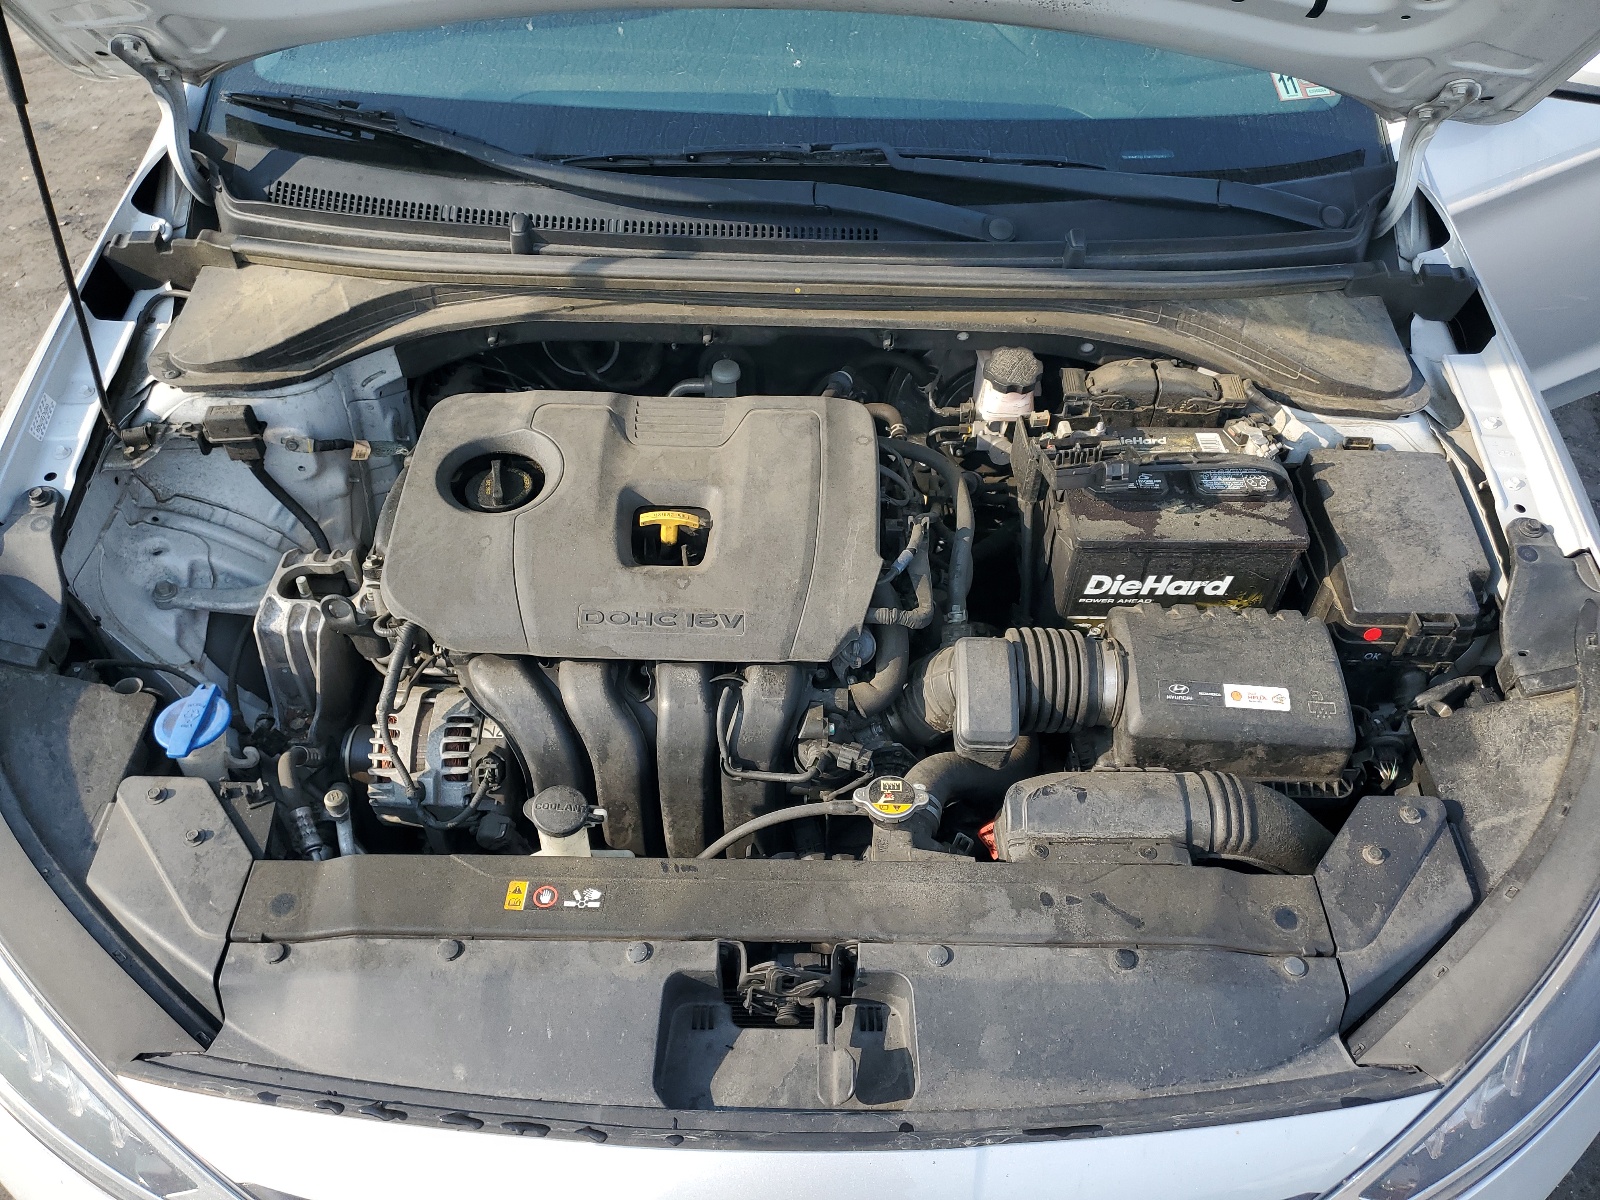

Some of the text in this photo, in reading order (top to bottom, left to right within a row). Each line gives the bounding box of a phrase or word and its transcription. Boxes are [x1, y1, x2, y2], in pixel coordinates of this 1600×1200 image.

[1278, 74, 1299, 95] 11
[1118, 436, 1167, 445] ieHard
[1083, 574, 1235, 596] DieHard
[581, 609, 744, 629] DOHC 16V
[1363, 652, 1382, 660] OK
[535, 802, 587, 814] COOLANT
